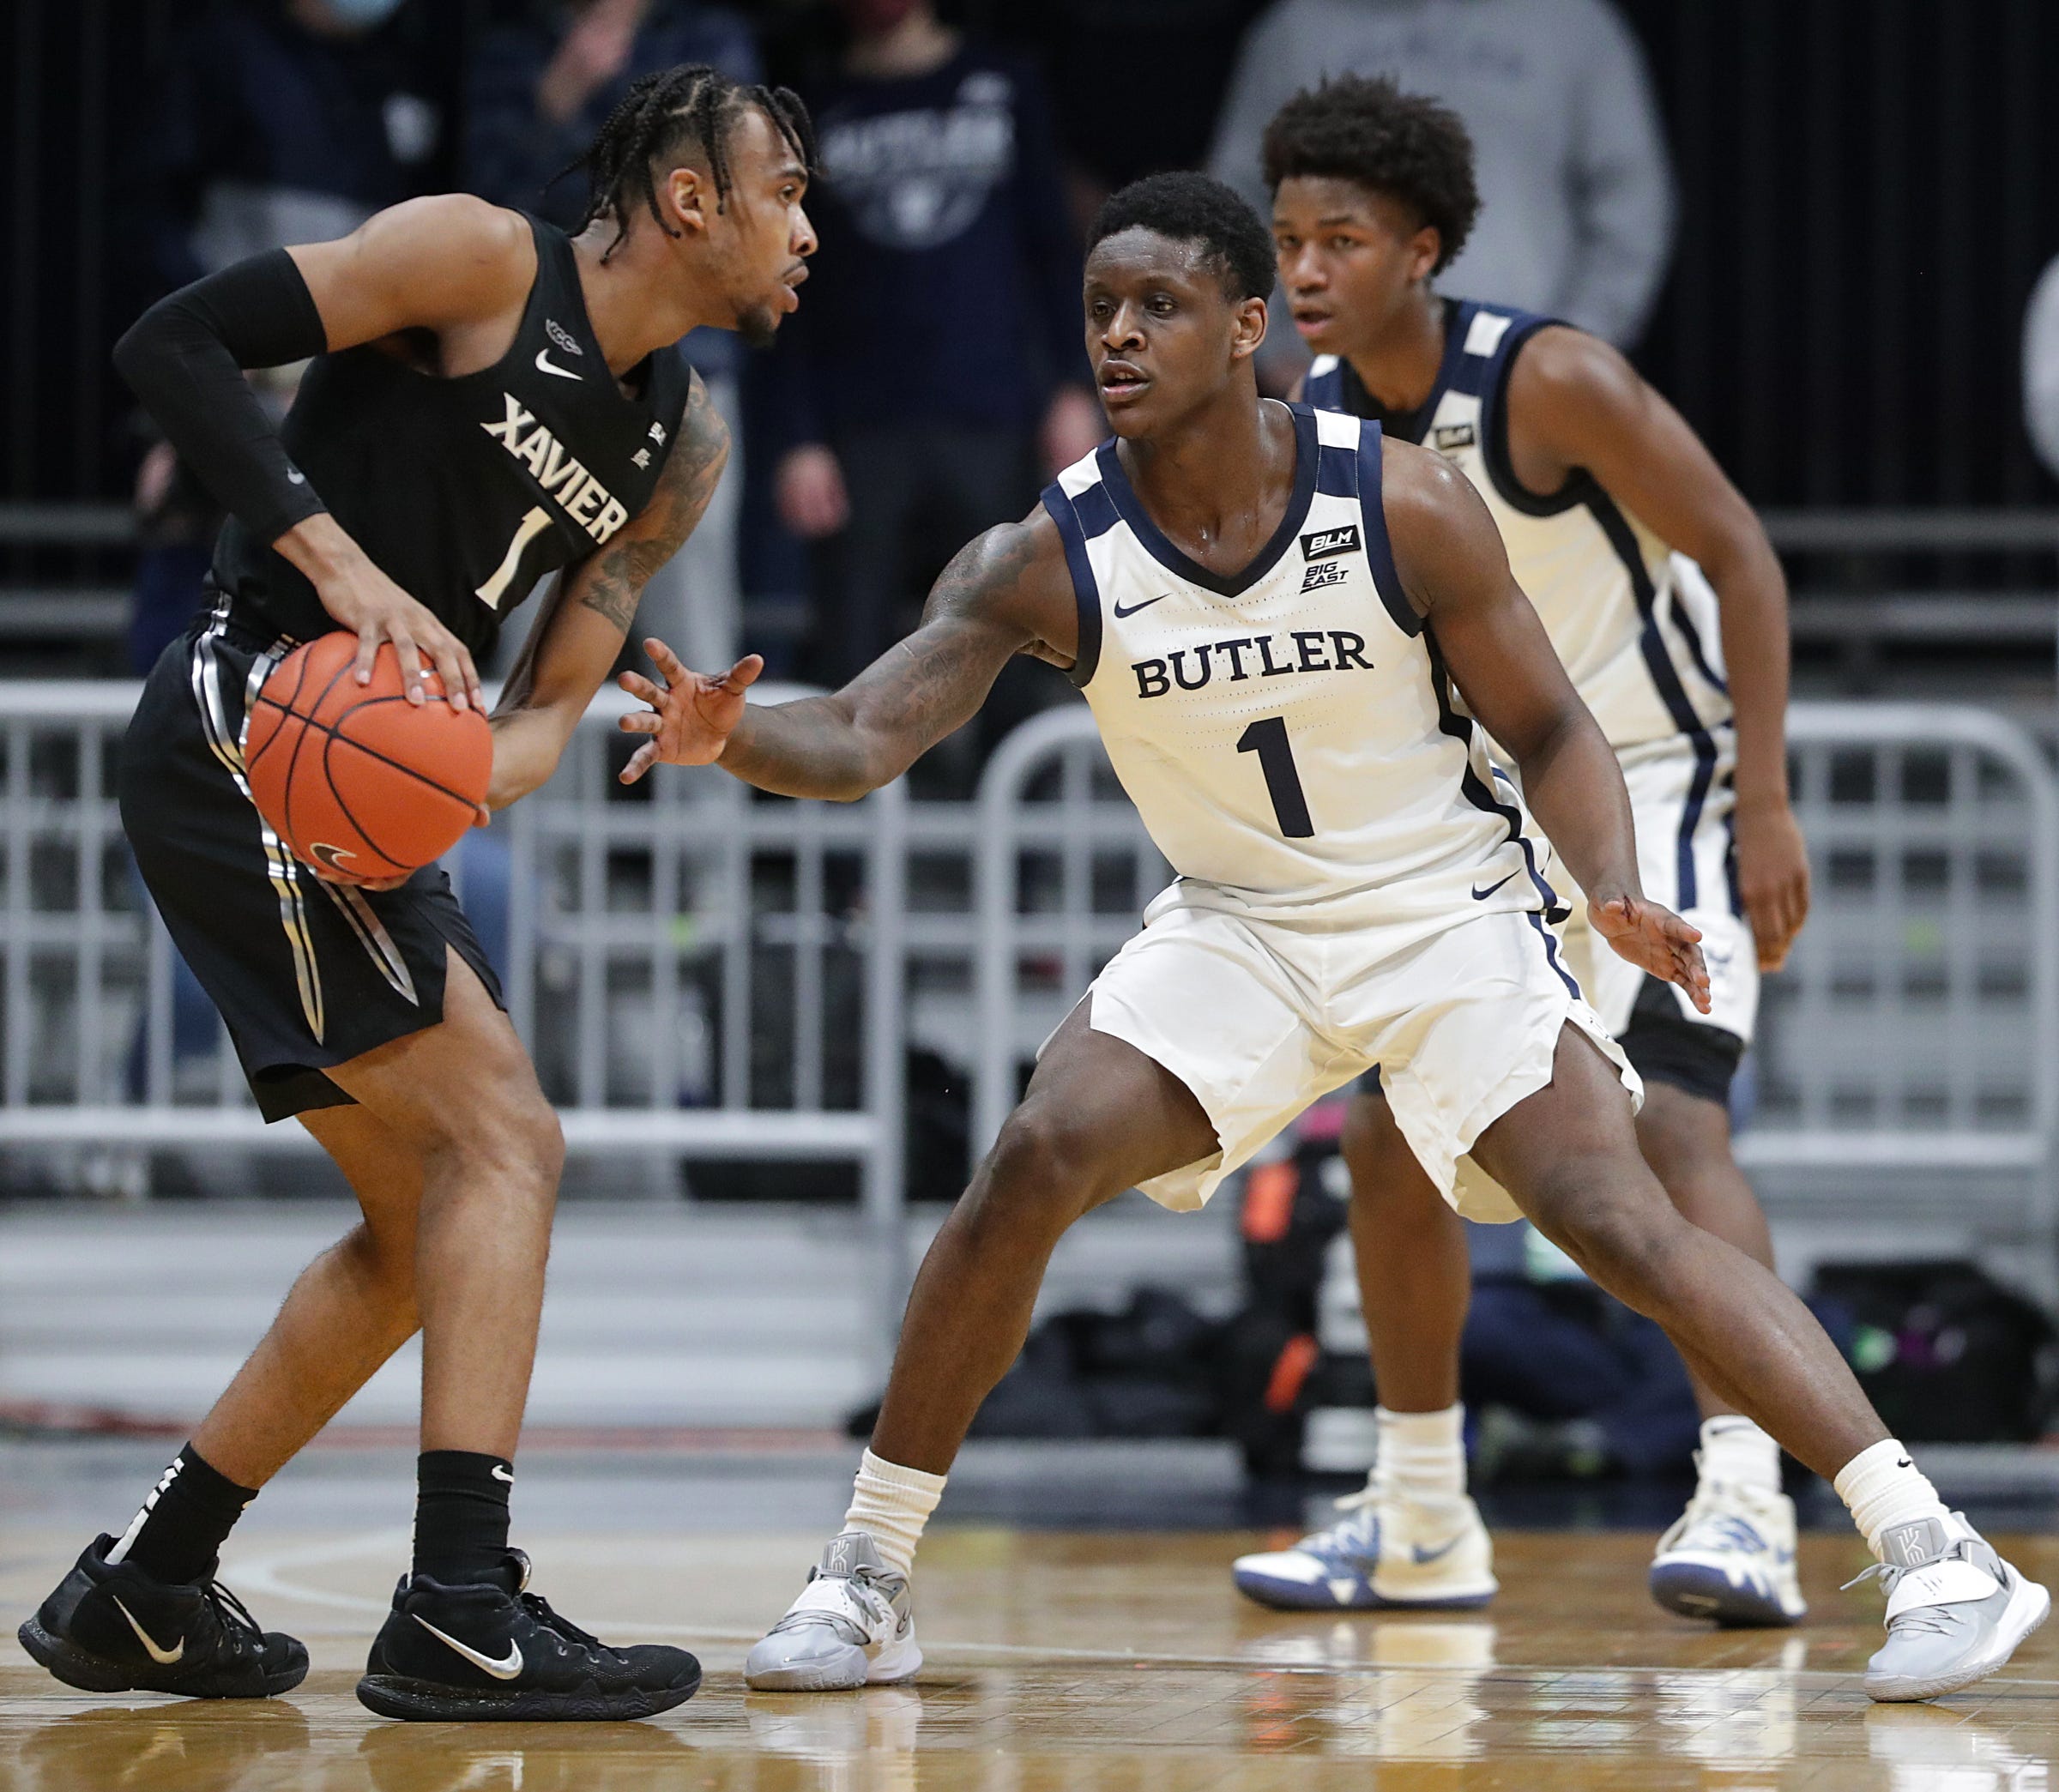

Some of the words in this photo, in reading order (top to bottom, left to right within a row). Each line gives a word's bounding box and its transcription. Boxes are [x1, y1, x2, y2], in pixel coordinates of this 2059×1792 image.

[480, 391, 629, 545] XAVIER
[474, 505, 555, 611] 1
[1305, 561, 1338, 577] BIG
[1309, 529, 1353, 550] BLM
[1301, 570, 1350, 588] EAST
[1131, 631, 1374, 698] BUTLER
[1236, 715, 1315, 838] 1
